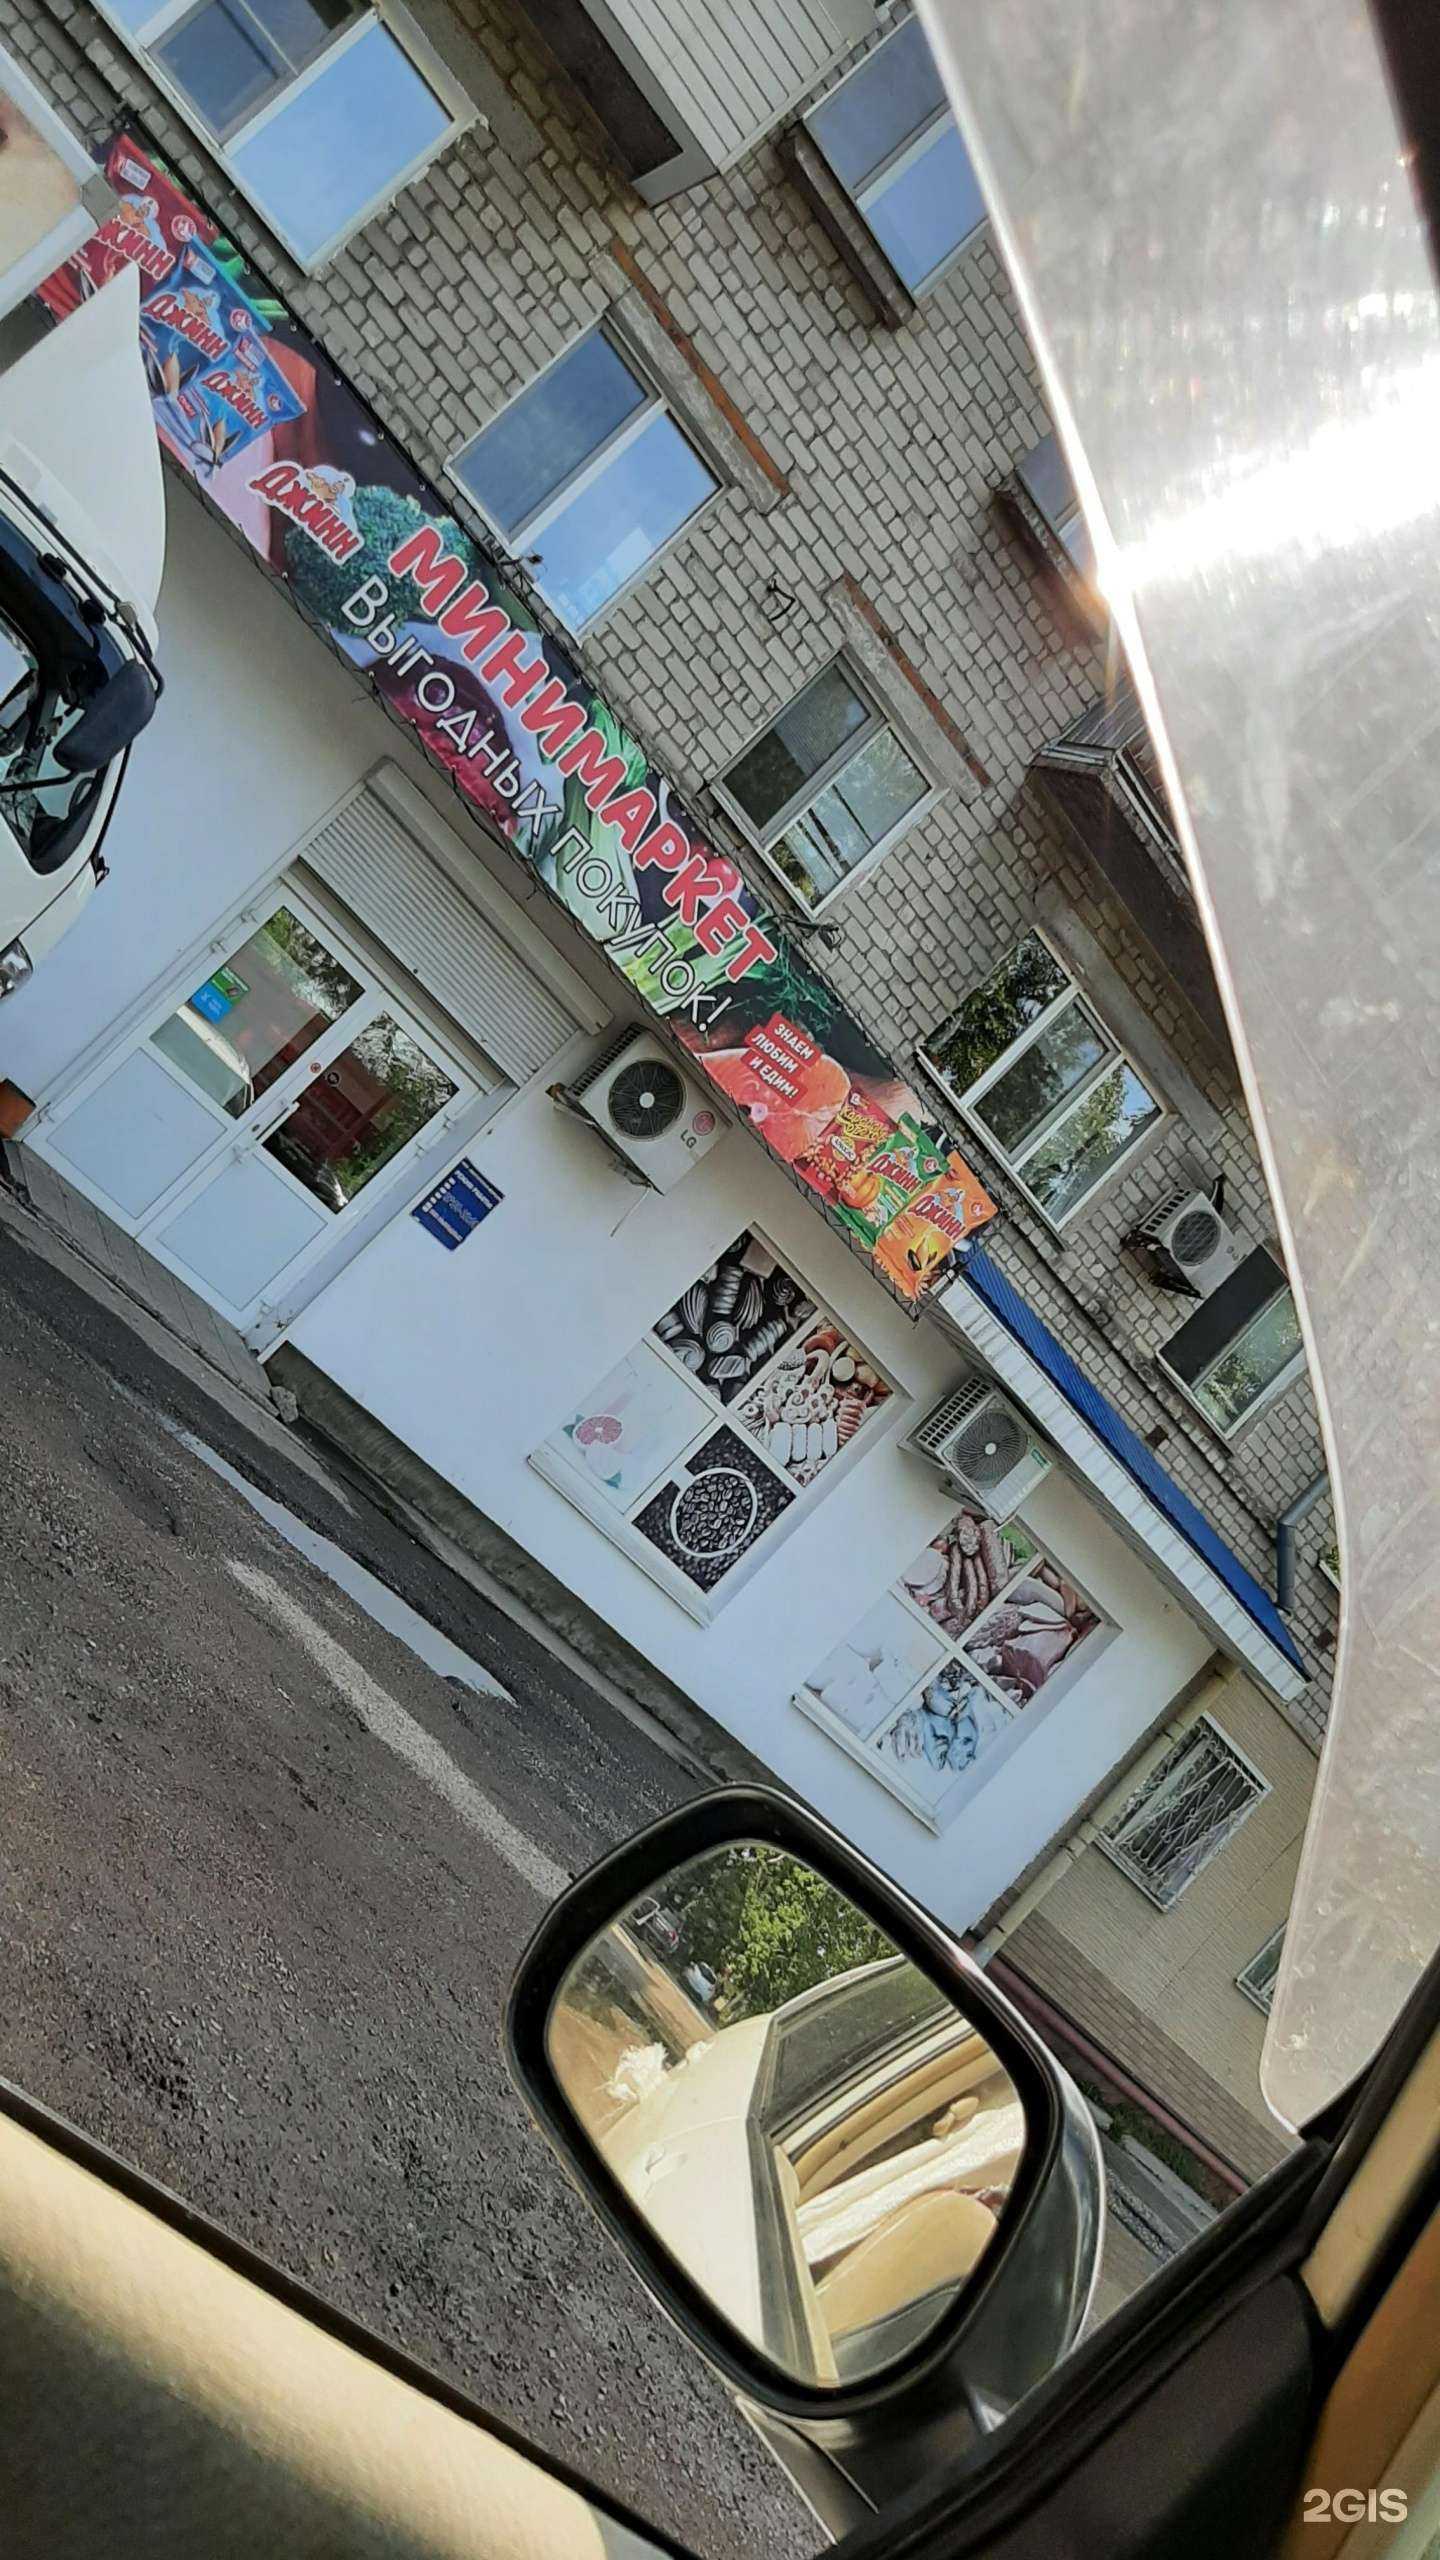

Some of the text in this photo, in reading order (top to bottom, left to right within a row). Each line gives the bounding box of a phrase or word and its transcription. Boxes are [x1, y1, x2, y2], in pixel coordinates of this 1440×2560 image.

[94, 217, 175, 280] ЖИНН
[142, 292, 230, 361] ДЖИНН
[201, 371, 270, 429] ДЖИНН
[248, 465, 361, 561] ДЖИНН
[387, 525, 778, 983] МИНИМАРКЕТ
[751, 1032, 799, 1073] ЛЮБИМ
[774, 1023, 815, 1060] ЗНАЕМ
[749, 1056, 799, 1098] И ЕДИМ!
[680, 1129, 698, 1149] LG
[866, 1153, 922, 1195] ДЖИНН
[907, 1194, 966, 1241] ДЖИНН
